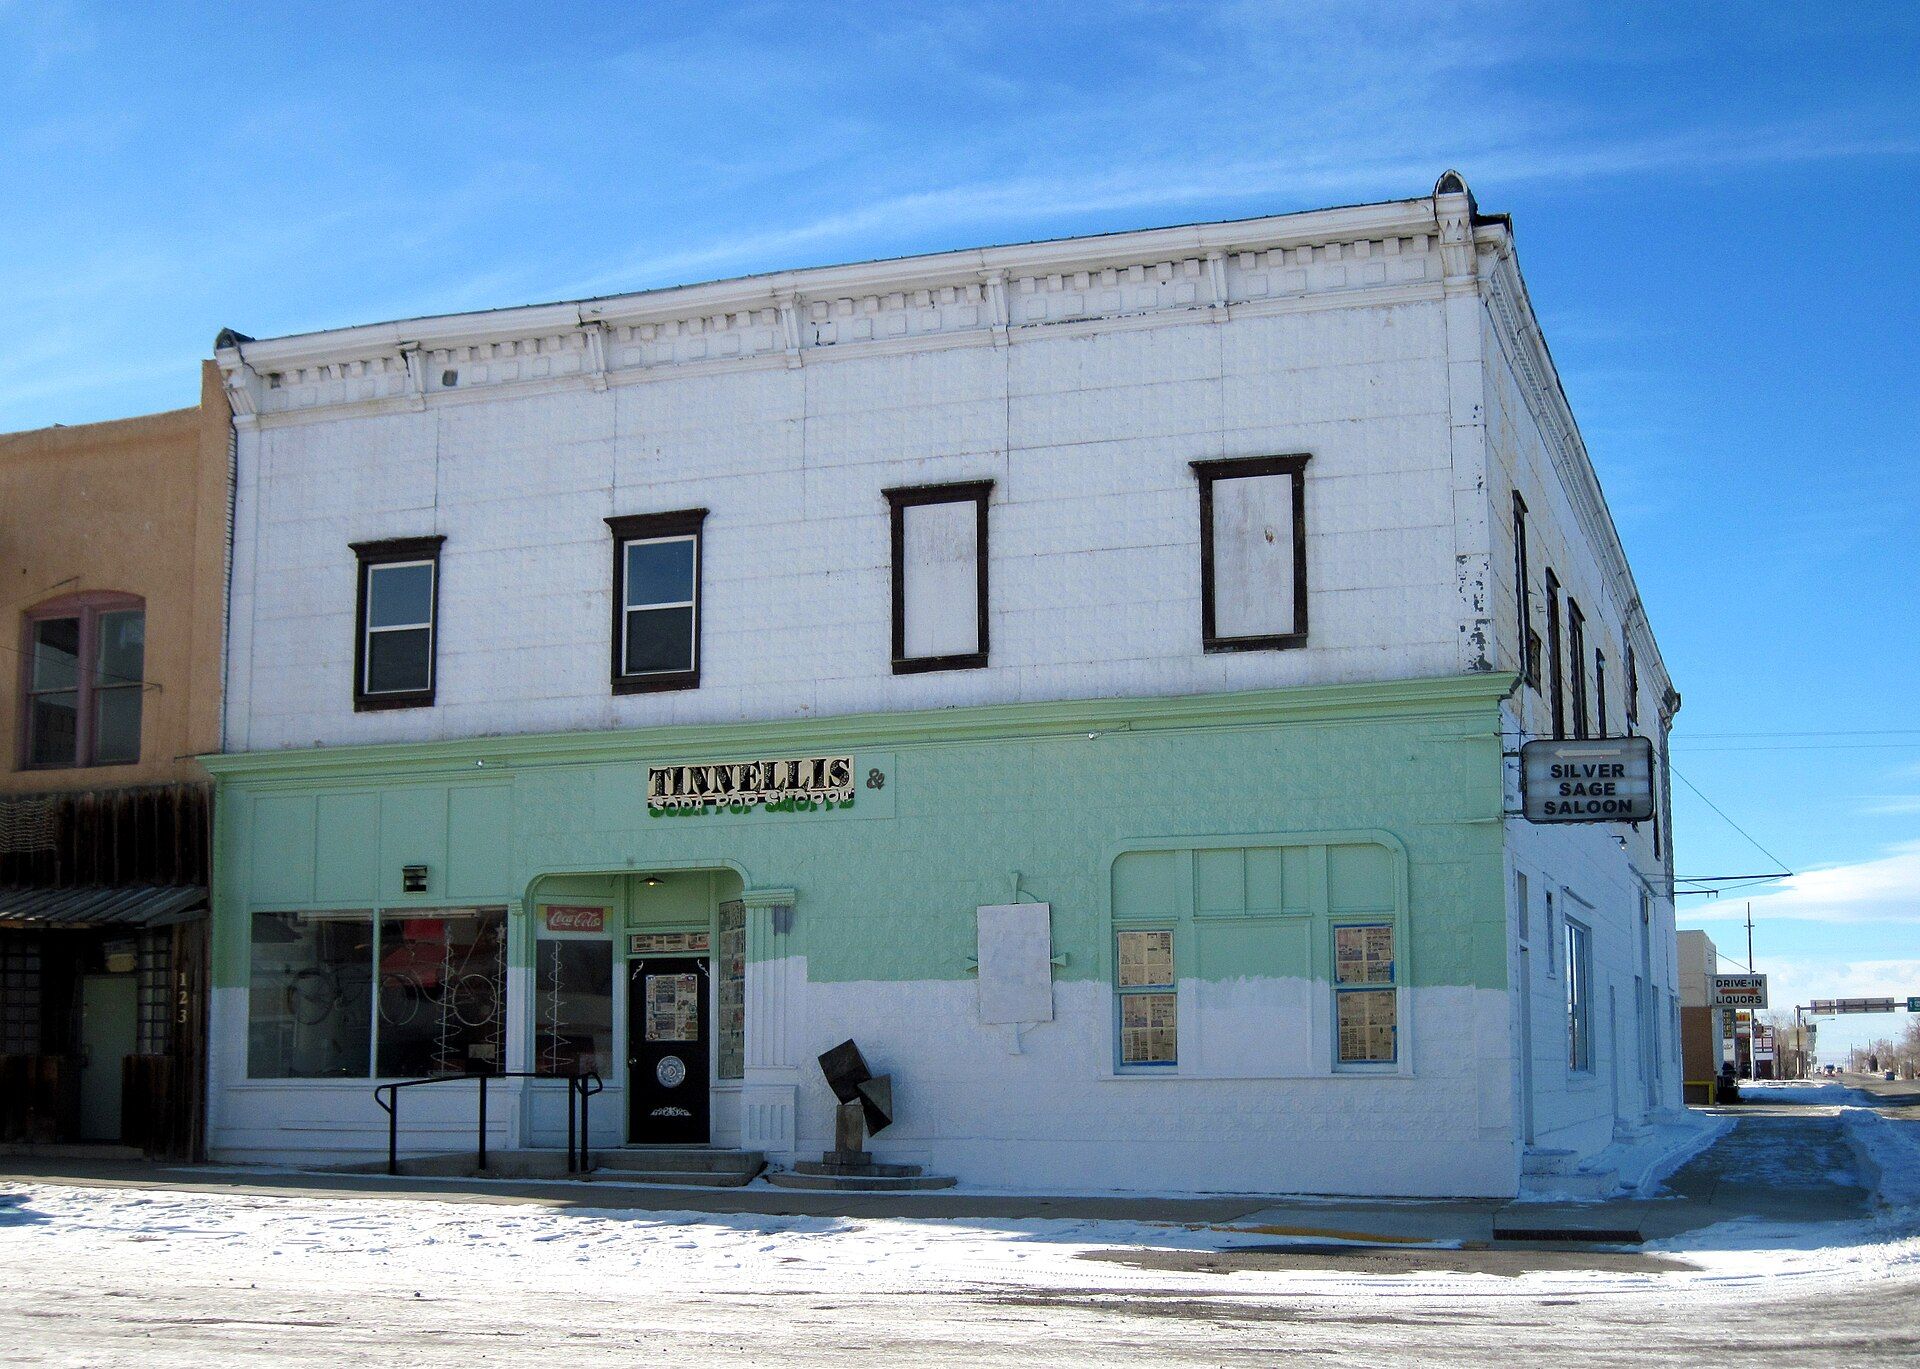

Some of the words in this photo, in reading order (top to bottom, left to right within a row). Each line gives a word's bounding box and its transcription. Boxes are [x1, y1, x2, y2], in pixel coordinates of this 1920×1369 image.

[649, 759, 850, 797] TINNELLIS
[1550, 764, 1625, 778] SILVER
[866, 768, 885, 790] &
[1559, 782, 1616, 796] SAGE
[650, 796, 709, 818] SODA
[714, 793, 760, 815] POP
[1544, 799, 1632, 815] SALOON
[1716, 979, 1762, 987] DRIVE-IN
[1716, 996, 1762, 1004] LIQUORS
